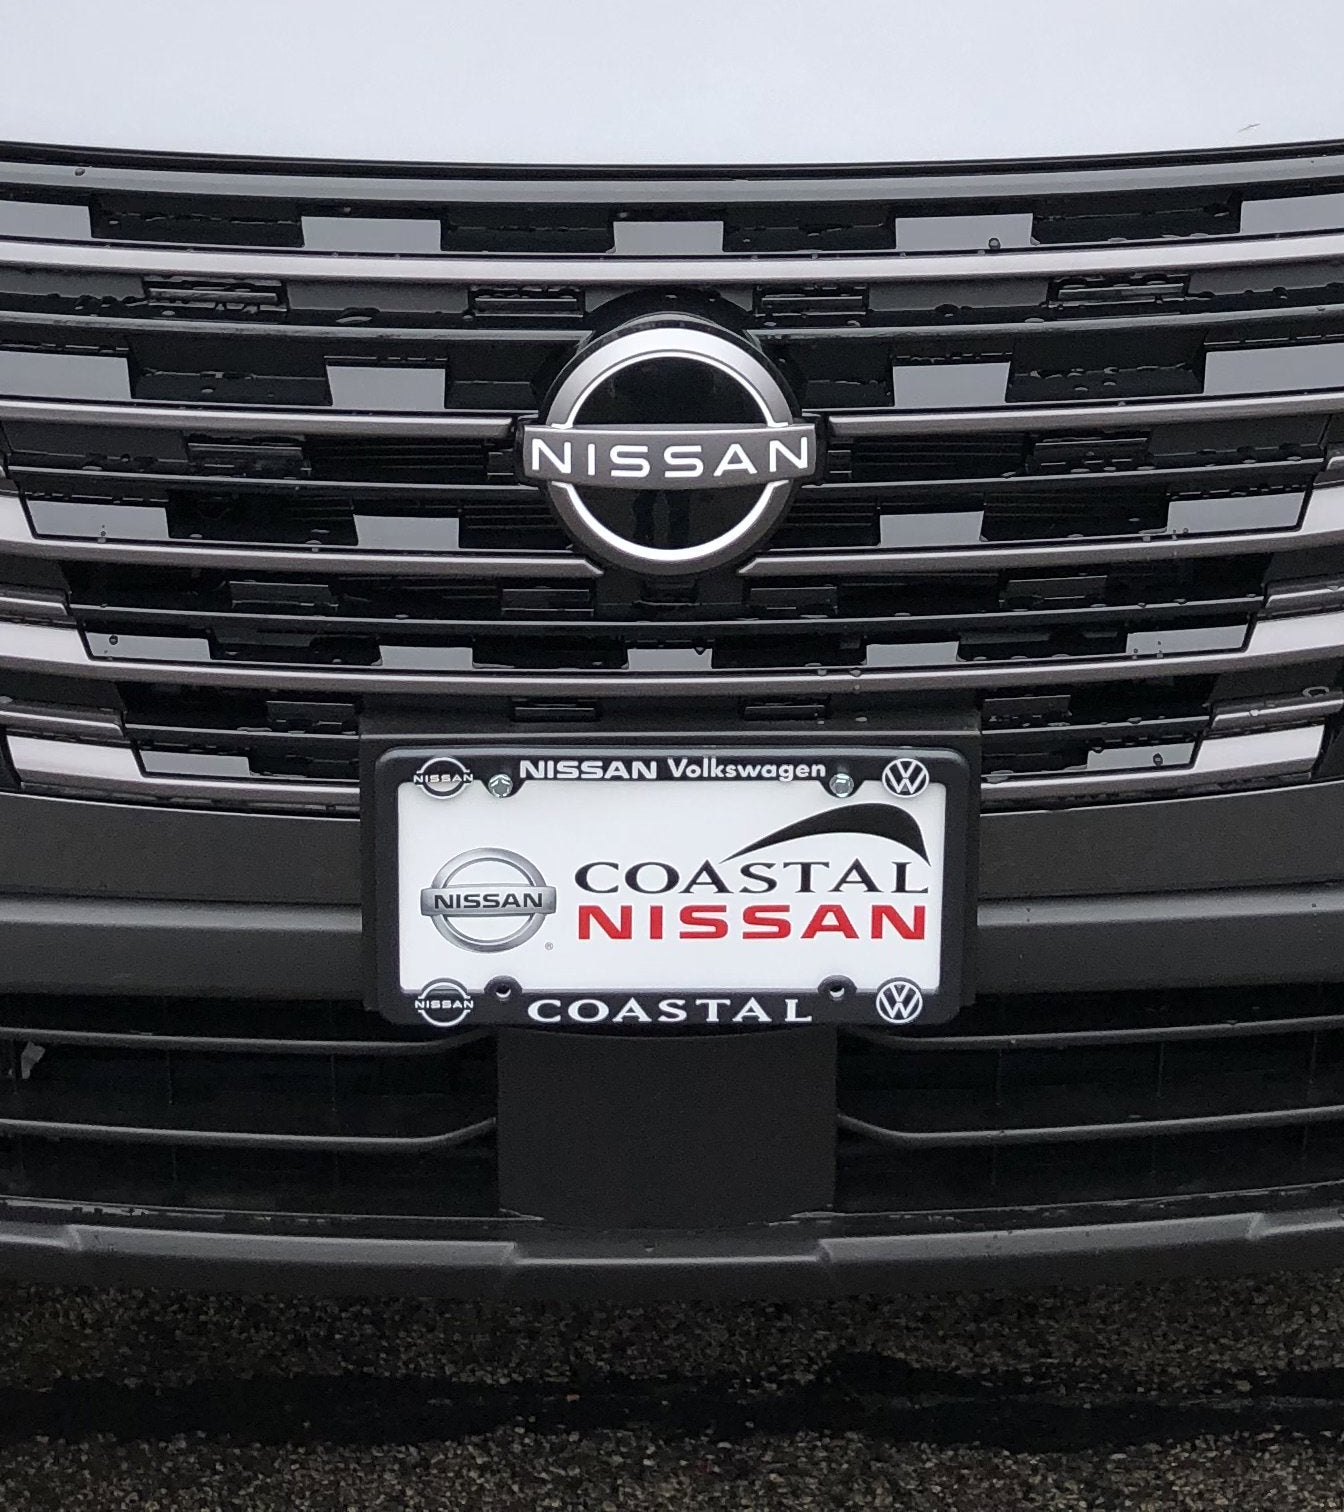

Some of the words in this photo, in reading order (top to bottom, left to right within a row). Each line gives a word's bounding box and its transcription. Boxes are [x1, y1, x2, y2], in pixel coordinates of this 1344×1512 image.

[531, 436, 808, 478] NISSAN
[413, 773, 473, 784] NISSAN
[519, 759, 657, 780] NISSAN
[667, 757, 827, 782] Volkswagen
[574, 858, 929, 894] COASTAL
[434, 893, 543, 909] NISSAN
[577, 904, 926, 940] NISSAN
[414, 999, 474, 1009] NISSAN
[527, 997, 812, 1023] COASTAL
